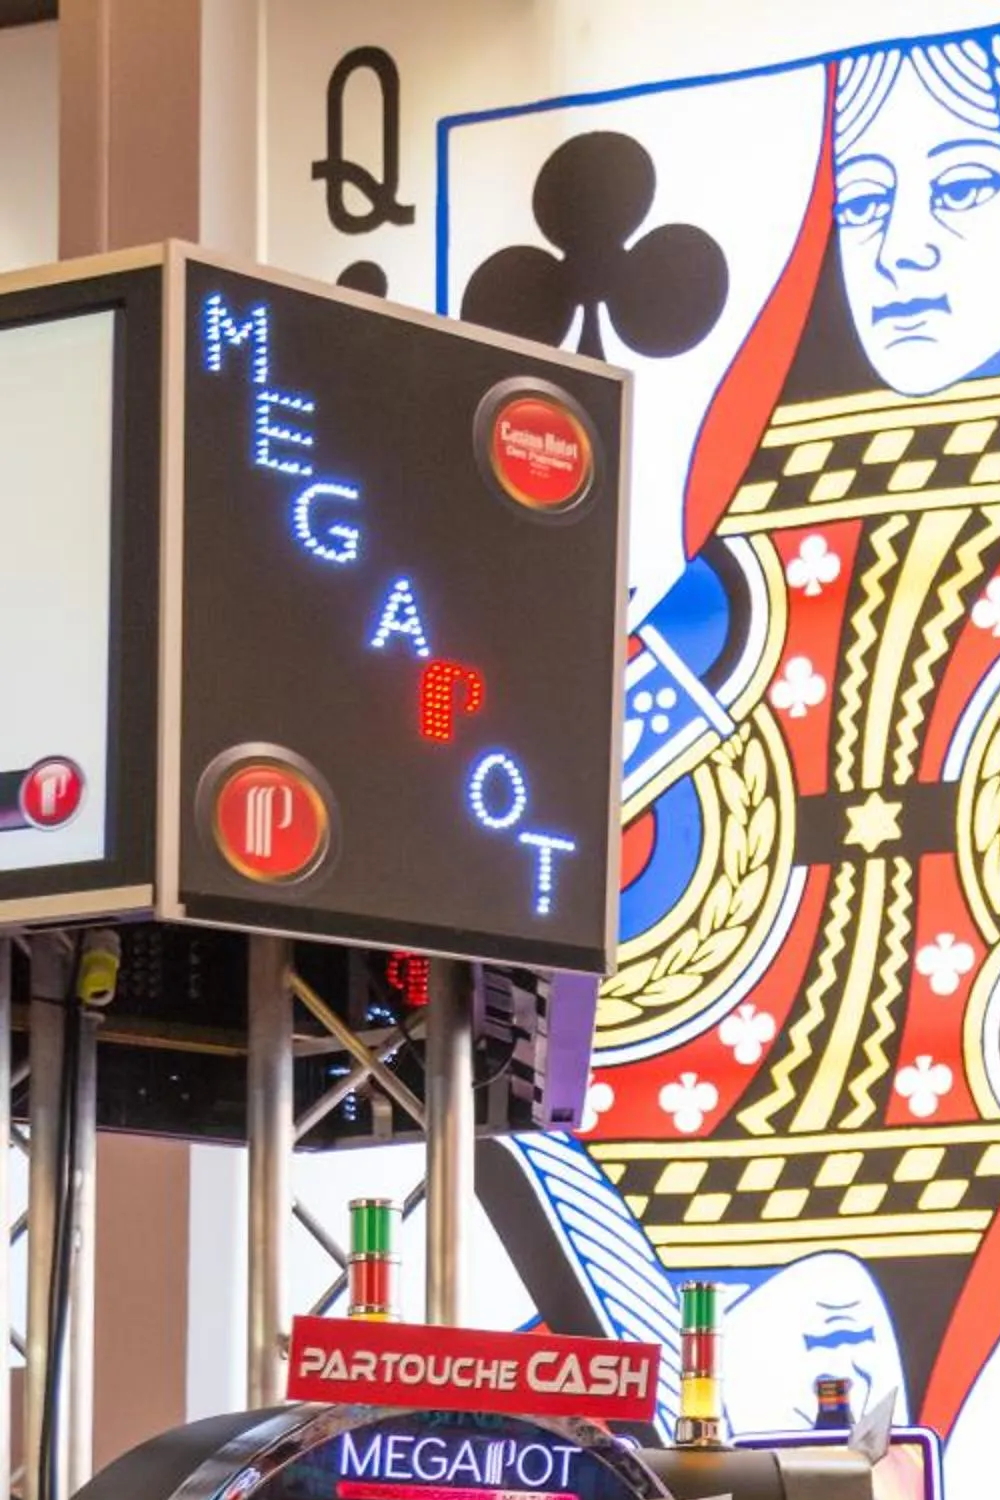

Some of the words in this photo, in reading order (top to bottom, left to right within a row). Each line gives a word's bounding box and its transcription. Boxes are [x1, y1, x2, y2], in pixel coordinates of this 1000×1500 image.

[312, 46, 415, 234] Q
[300, 1347, 518, 1391] PARTOUCHE
[526, 1350, 650, 1398] CASH
[340, 1431, 583, 1487] MEGAPOT
